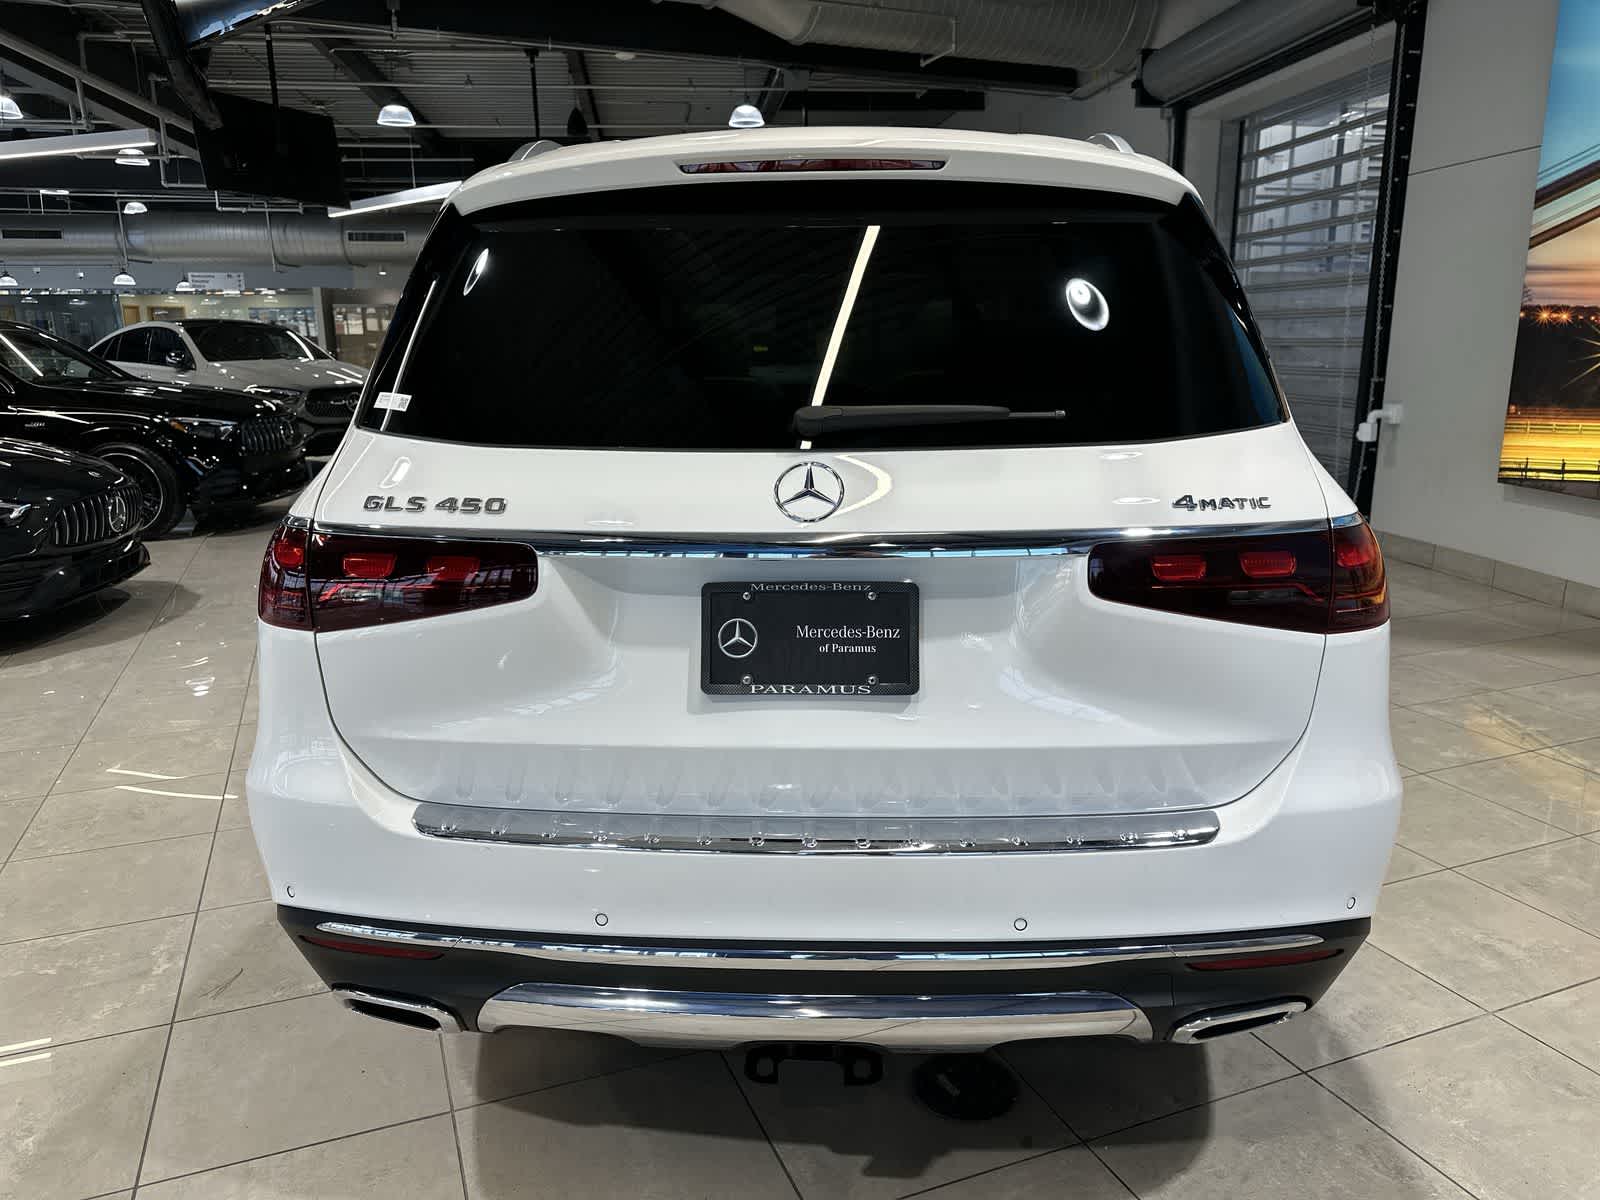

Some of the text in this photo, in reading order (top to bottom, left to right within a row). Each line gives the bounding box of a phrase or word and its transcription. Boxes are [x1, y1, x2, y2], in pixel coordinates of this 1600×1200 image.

[363, 495, 507, 514] GLS 450
[1172, 494, 1272, 511] 4MATIC
[750, 582, 872, 592] Mercedes-Benz
[796, 624, 901, 639] Mercedes-Benz
[819, 643, 877, 654] of Paramus
[750, 684, 872, 695] PARAMUS
